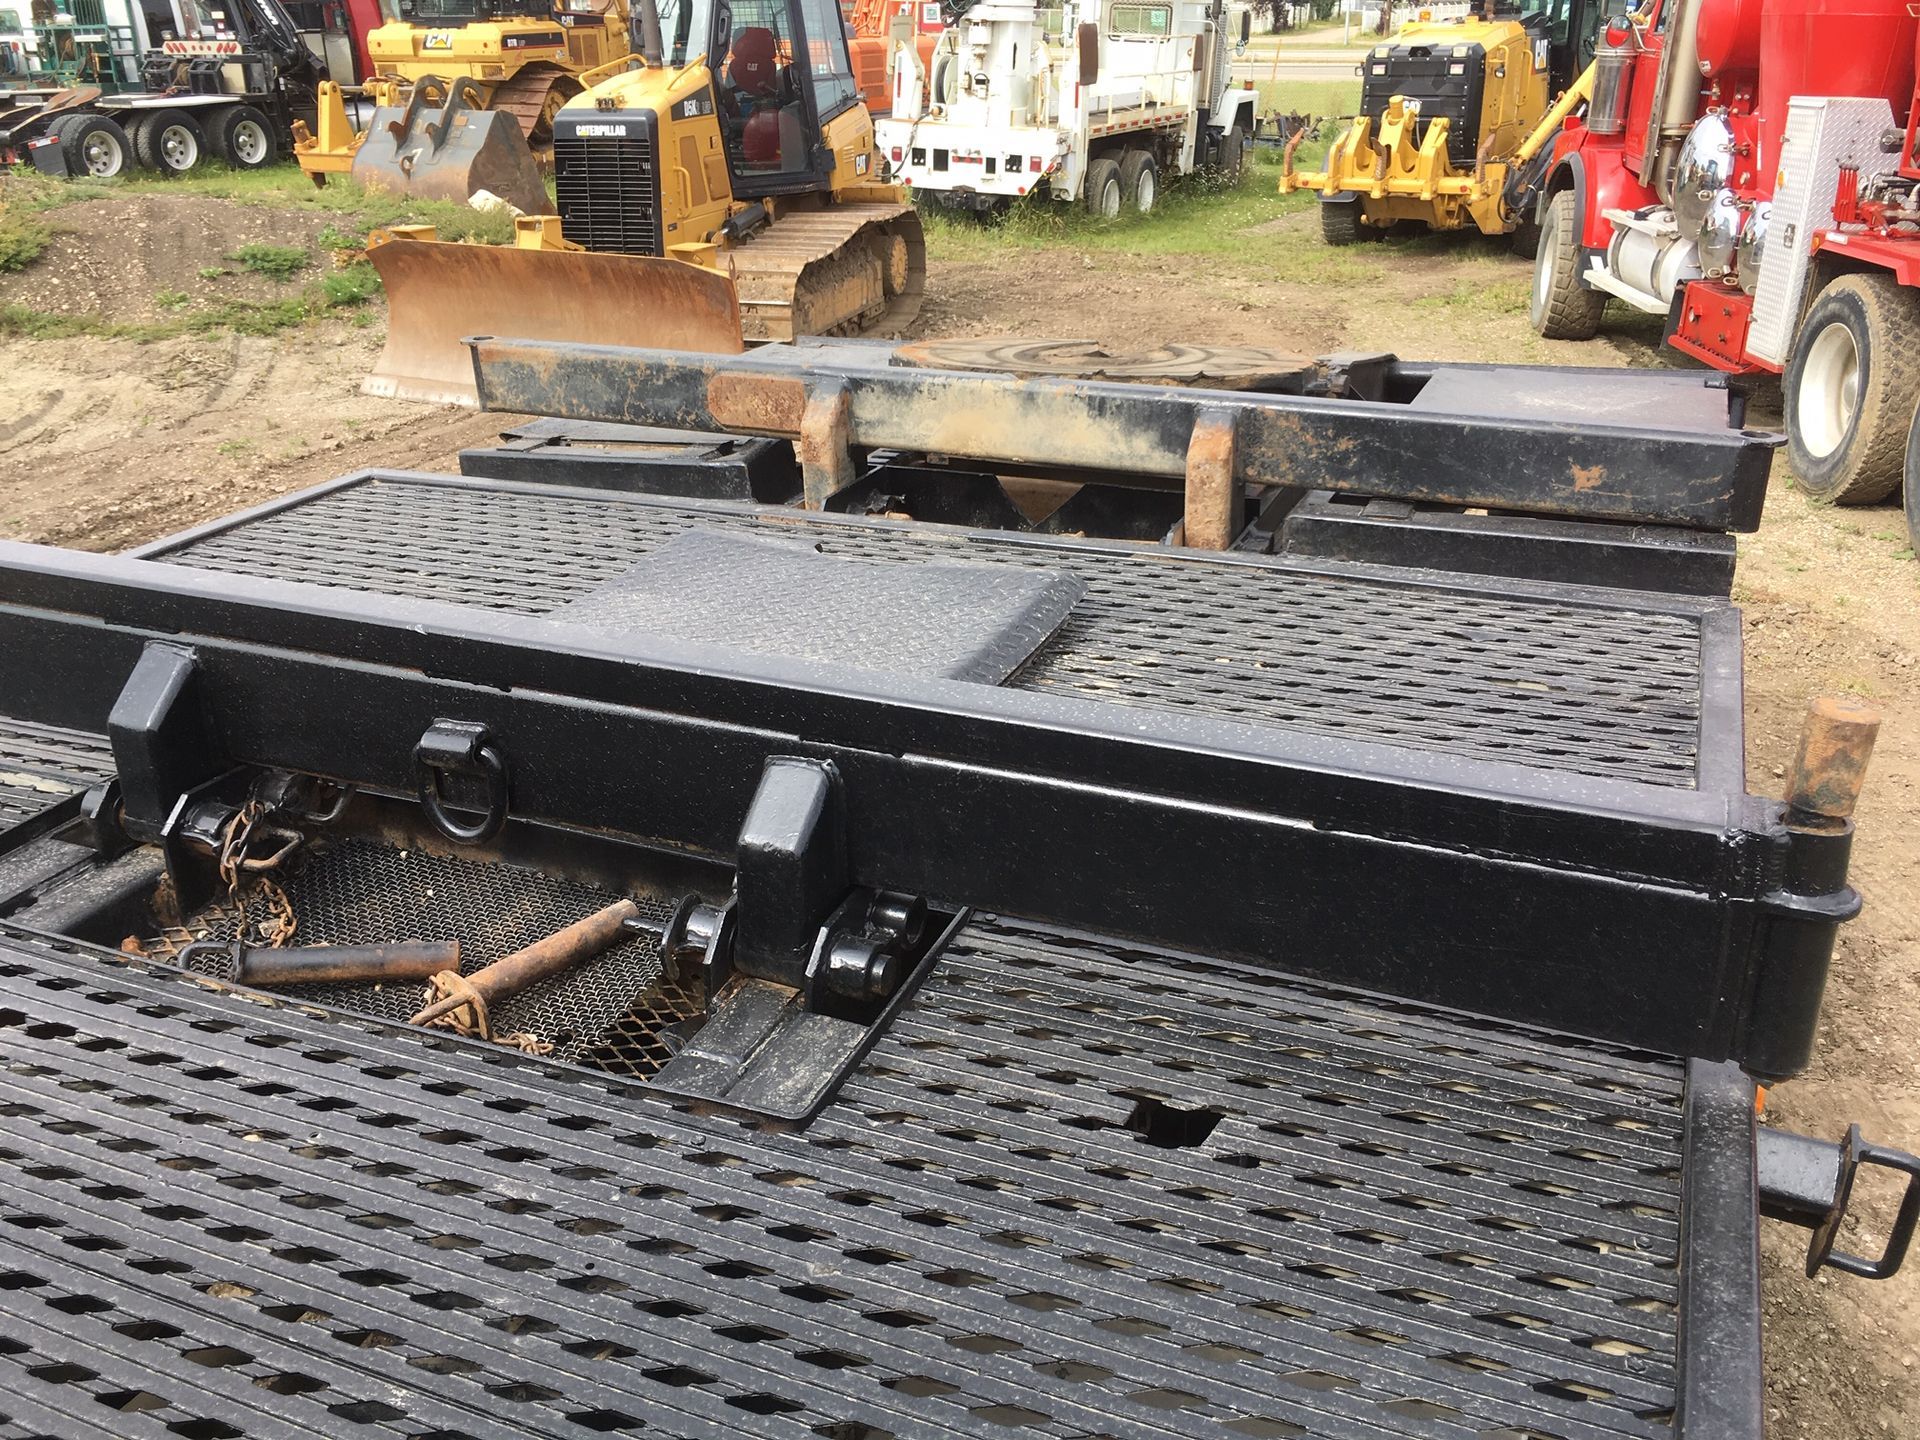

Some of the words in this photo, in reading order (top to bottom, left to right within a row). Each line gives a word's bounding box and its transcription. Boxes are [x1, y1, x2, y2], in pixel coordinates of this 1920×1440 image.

[561, 15, 574, 27] CAT
[1535, 38, 1549, 70] CAT
[746, 62, 759, 71] CAT
[575, 124, 627, 137] CATERPILLAR
[855, 154, 867, 175] CAT
